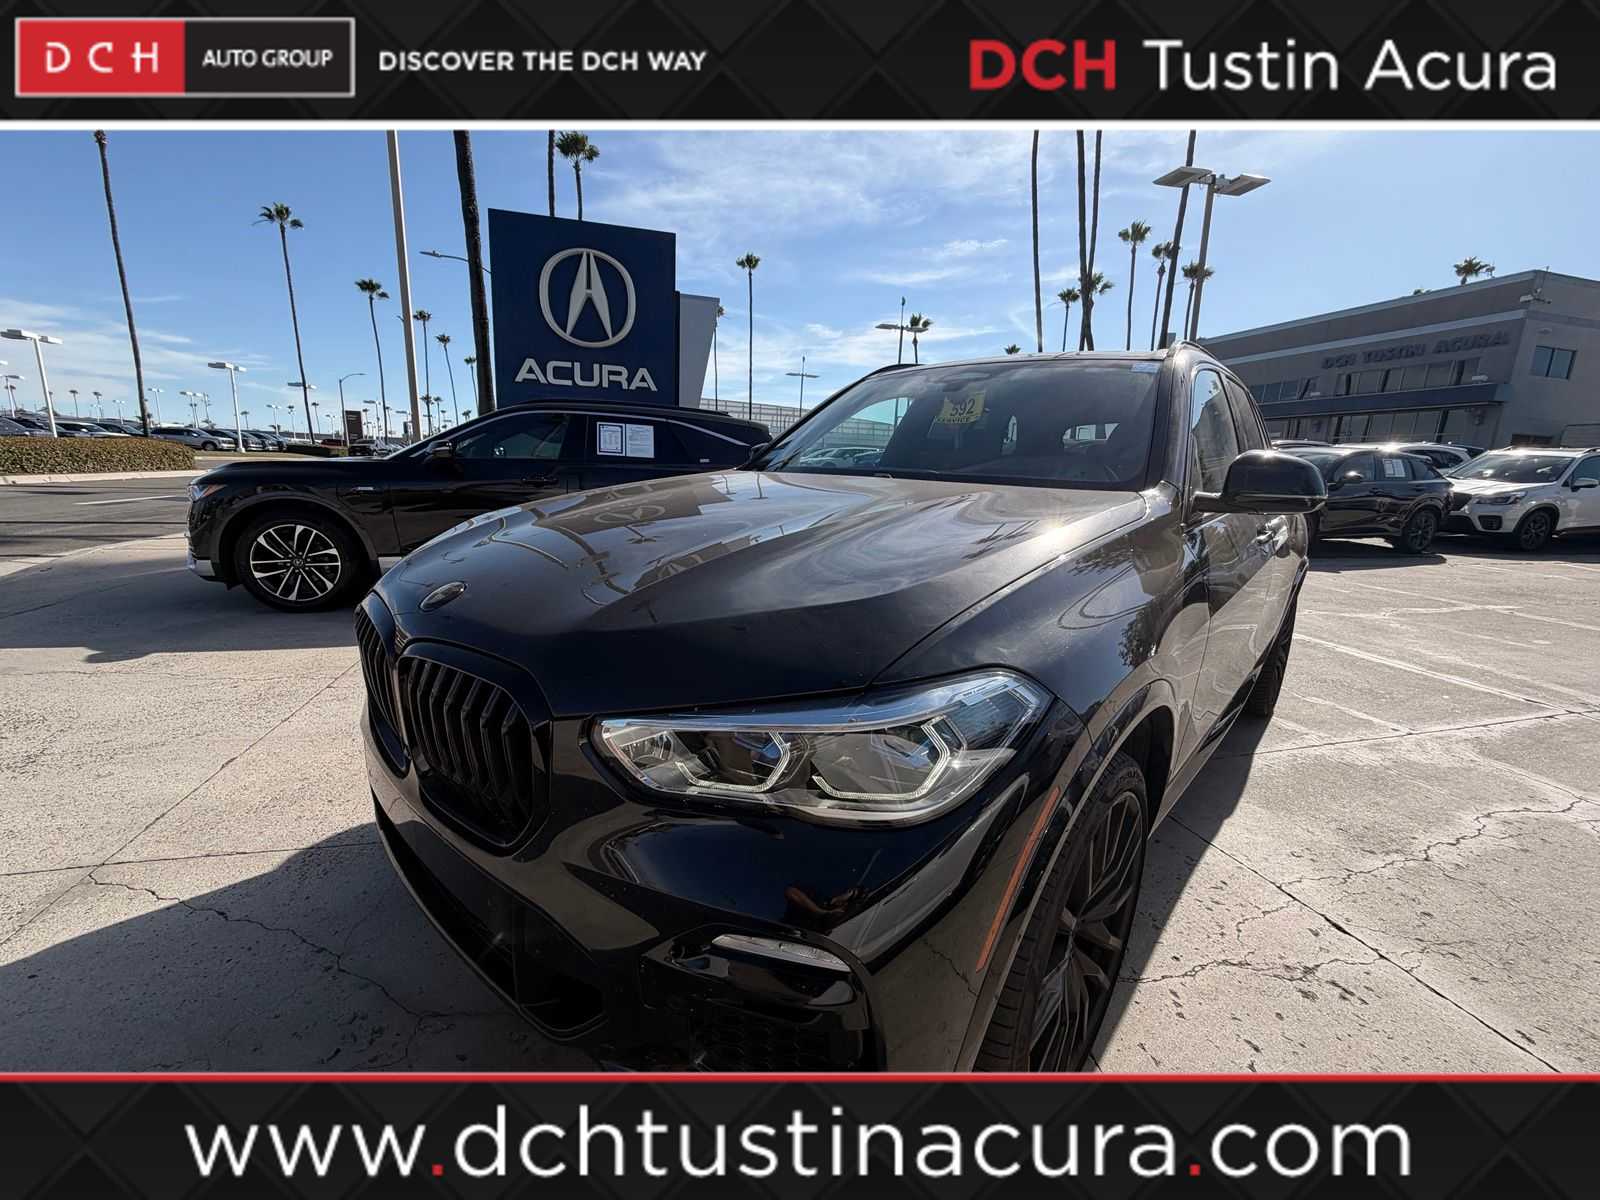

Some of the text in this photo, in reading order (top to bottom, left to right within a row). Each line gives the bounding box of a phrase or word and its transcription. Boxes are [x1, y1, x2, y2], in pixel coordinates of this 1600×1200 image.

[1362, 343, 1427, 364] TUSTIN
[1432, 331, 1510, 354] ACURA
[514, 357, 658, 392] ACURA
